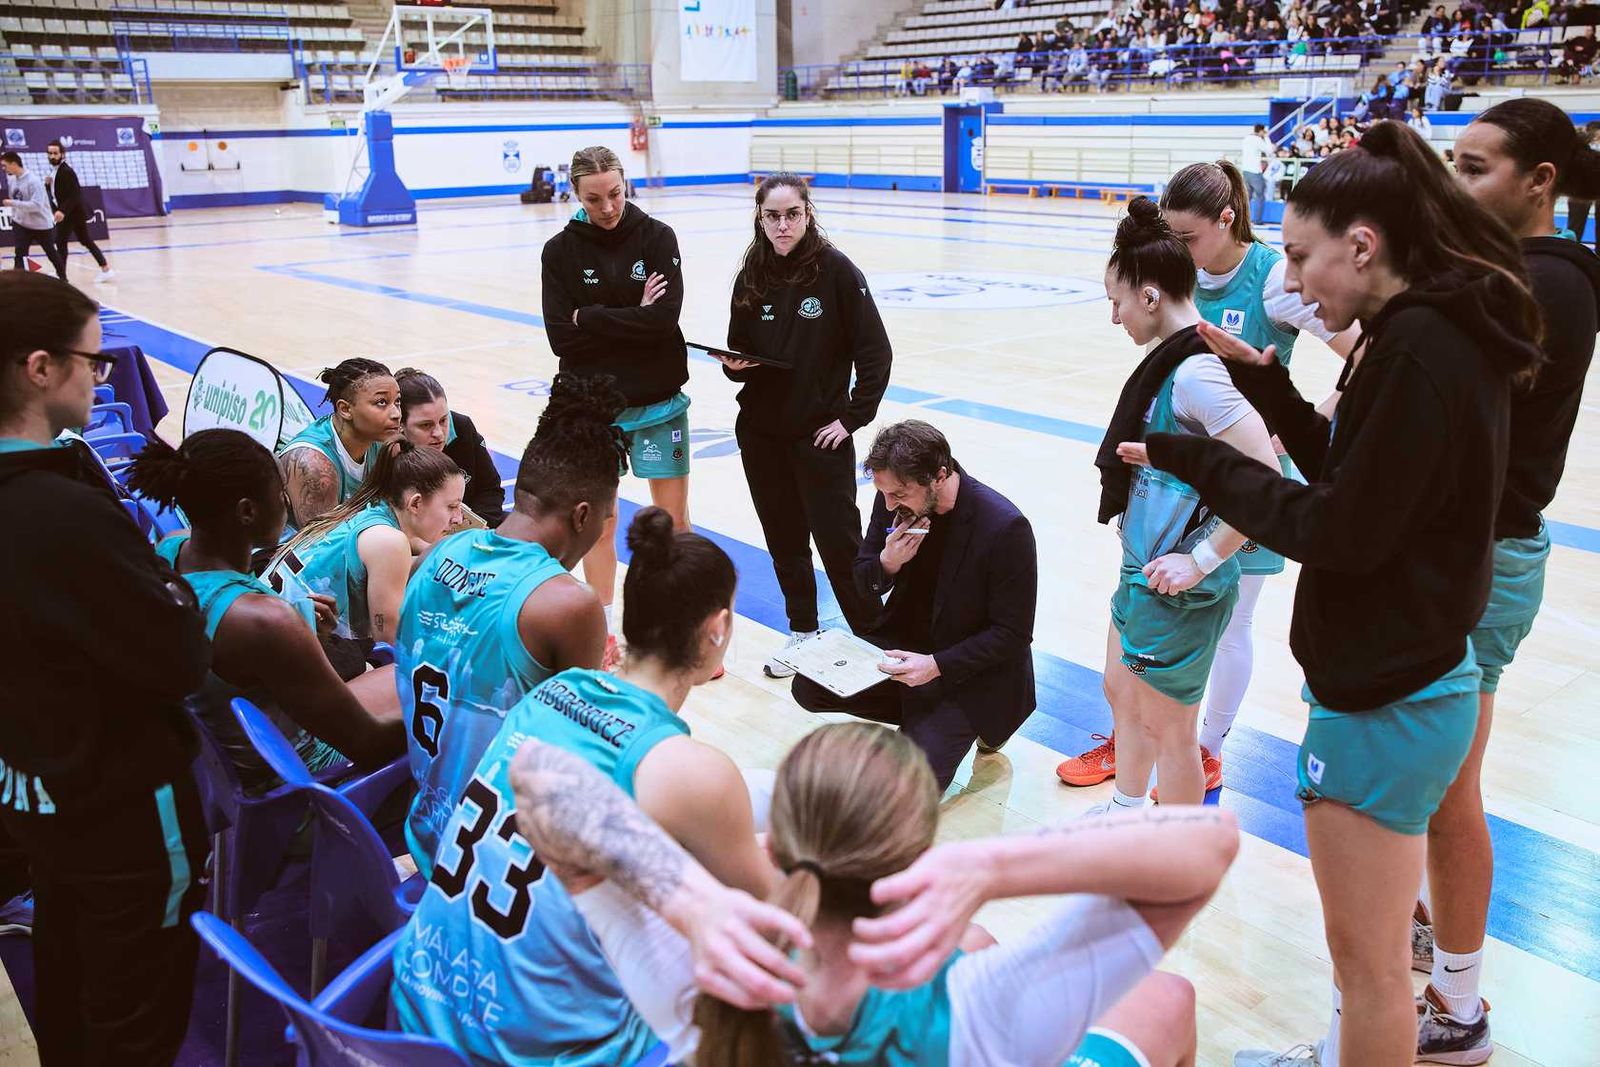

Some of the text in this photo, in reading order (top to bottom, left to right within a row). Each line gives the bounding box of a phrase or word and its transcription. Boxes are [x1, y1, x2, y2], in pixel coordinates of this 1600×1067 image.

[203, 380, 247, 425] unipiso
[411, 662, 450, 761] 6
[430, 776, 545, 941] 33
